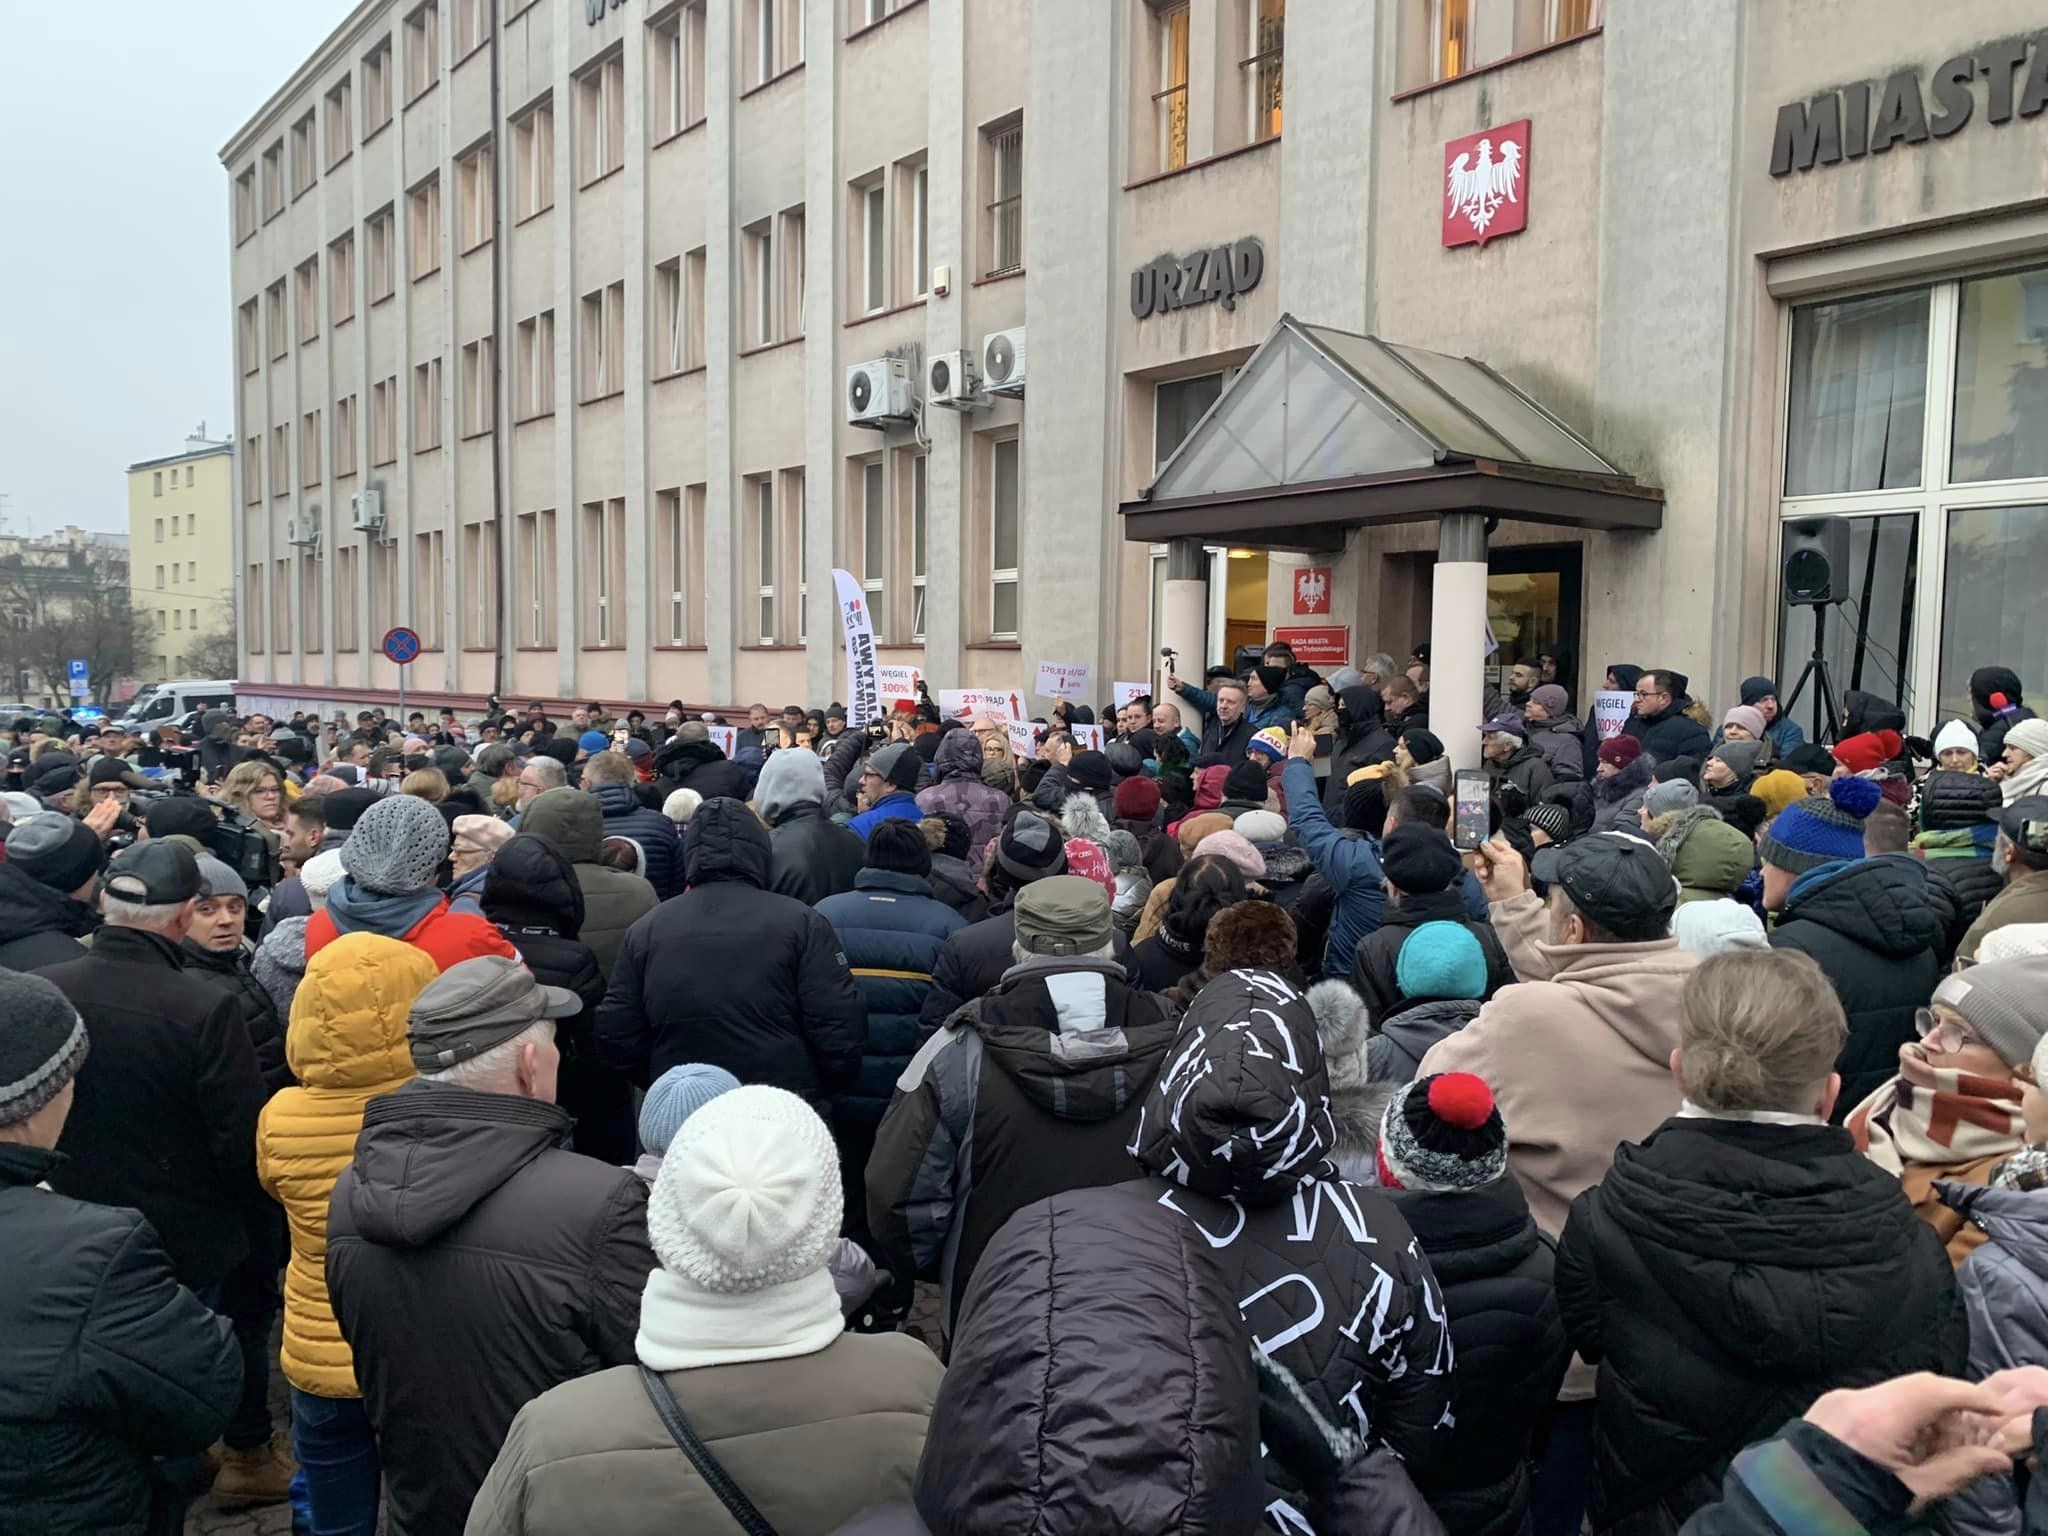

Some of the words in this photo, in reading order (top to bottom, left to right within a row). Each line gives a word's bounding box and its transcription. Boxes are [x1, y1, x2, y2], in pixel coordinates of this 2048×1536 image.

[1131, 238, 1264, 319] URZĄD
[72, 661, 84, 674] P
[880, 670, 908, 679] WĘGIEL
[882, 682, 909, 694] 300%
